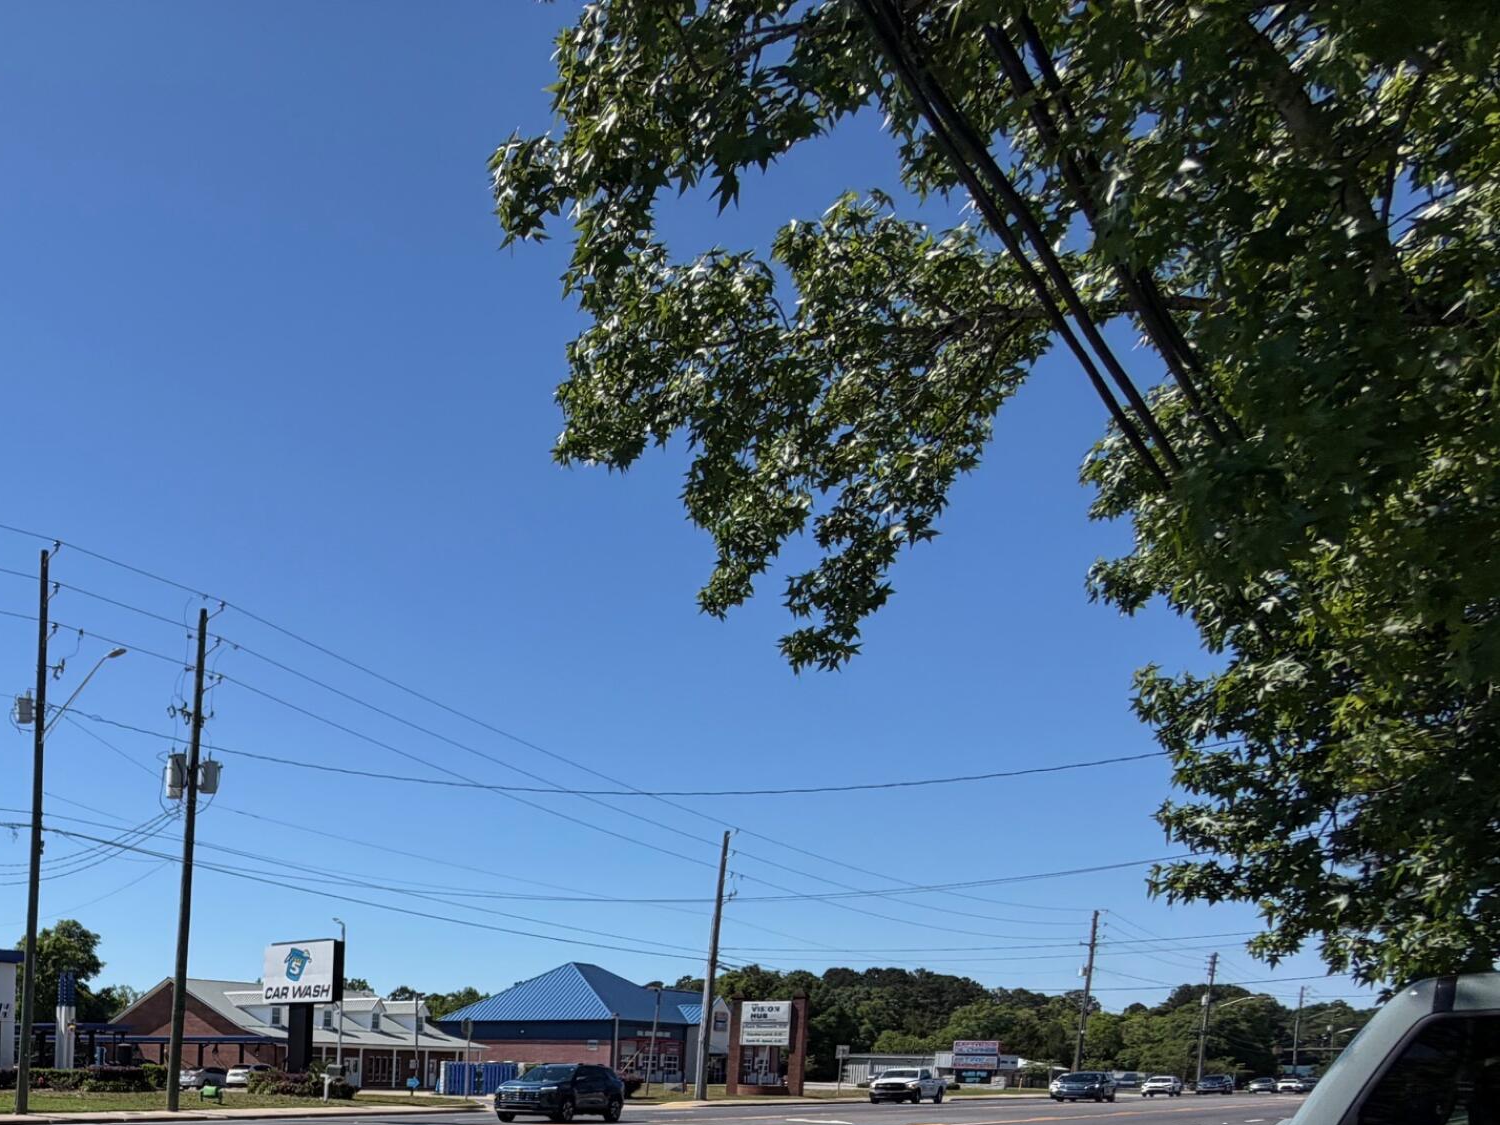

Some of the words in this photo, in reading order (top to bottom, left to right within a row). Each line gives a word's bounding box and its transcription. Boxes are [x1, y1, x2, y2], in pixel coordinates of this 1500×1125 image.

[264, 986, 290, 1000] CAR
[292, 984, 331, 999] WASH
[751, 1005, 781, 1013] VISON
